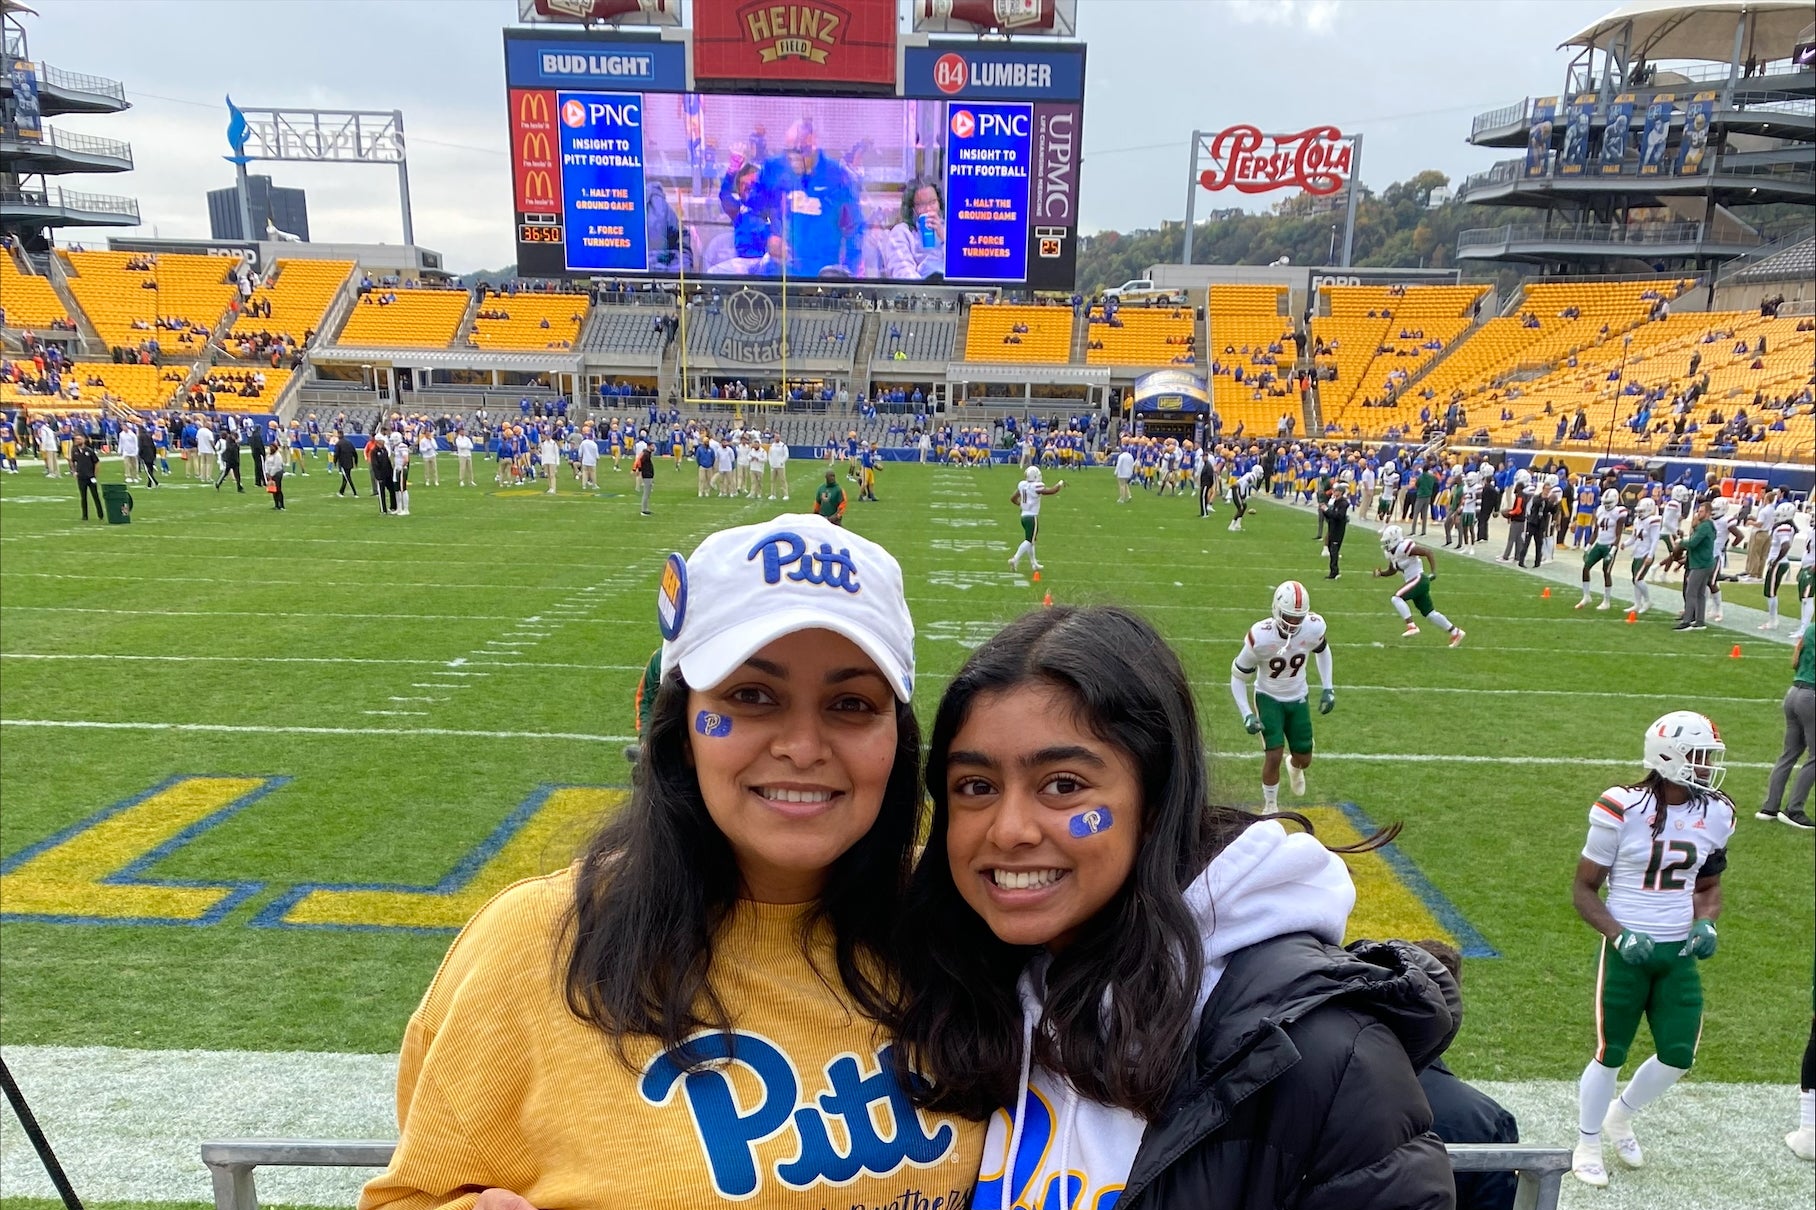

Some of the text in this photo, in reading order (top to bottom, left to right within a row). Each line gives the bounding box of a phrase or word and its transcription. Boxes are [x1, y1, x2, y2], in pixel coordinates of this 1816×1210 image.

[747, 5, 840, 45] HEINZ
[780, 39, 807, 53] FIELD
[543, 54, 650, 76] BUD LIGHT
[938, 61, 1052, 87] 84 LUMBER
[588, 103, 640, 127] PNC
[978, 113, 1028, 137] PNC
[258, 120, 407, 162] PEOPLES
[572, 138, 630, 152] INSIGHT TO
[564, 154, 642, 168] PITT FOOTBALL
[959, 148, 1017, 161] INSIGHT TO
[1037, 134, 1046, 177] CHANGING
[950, 164, 1027, 177] PITT FOOTBALL
[1045, 112, 1073, 218] UPMC
[581, 188, 629, 198] 1. HALT THE
[1036, 178, 1044, 217] MEDICINE
[575, 200, 635, 211] GROUND GAME
[964, 198, 1012, 209] 1. HALT THE
[958, 210, 1017, 221] GROUND GAME
[588, 226, 624, 235] 2. FORCE
[582, 237, 631, 248] TURNOVERS
[969, 235, 1004, 245] 2. FORCE
[962, 247, 1010, 257] TURNOVERS
[719, 336, 791, 365] Allstate
[1600, 518, 1609, 532] 41
[747, 531, 861, 594] Pitt
[1269, 653, 1306, 679] 99
[1641, 839, 1698, 891] 12
[638, 1028, 958, 1201] Pitt
